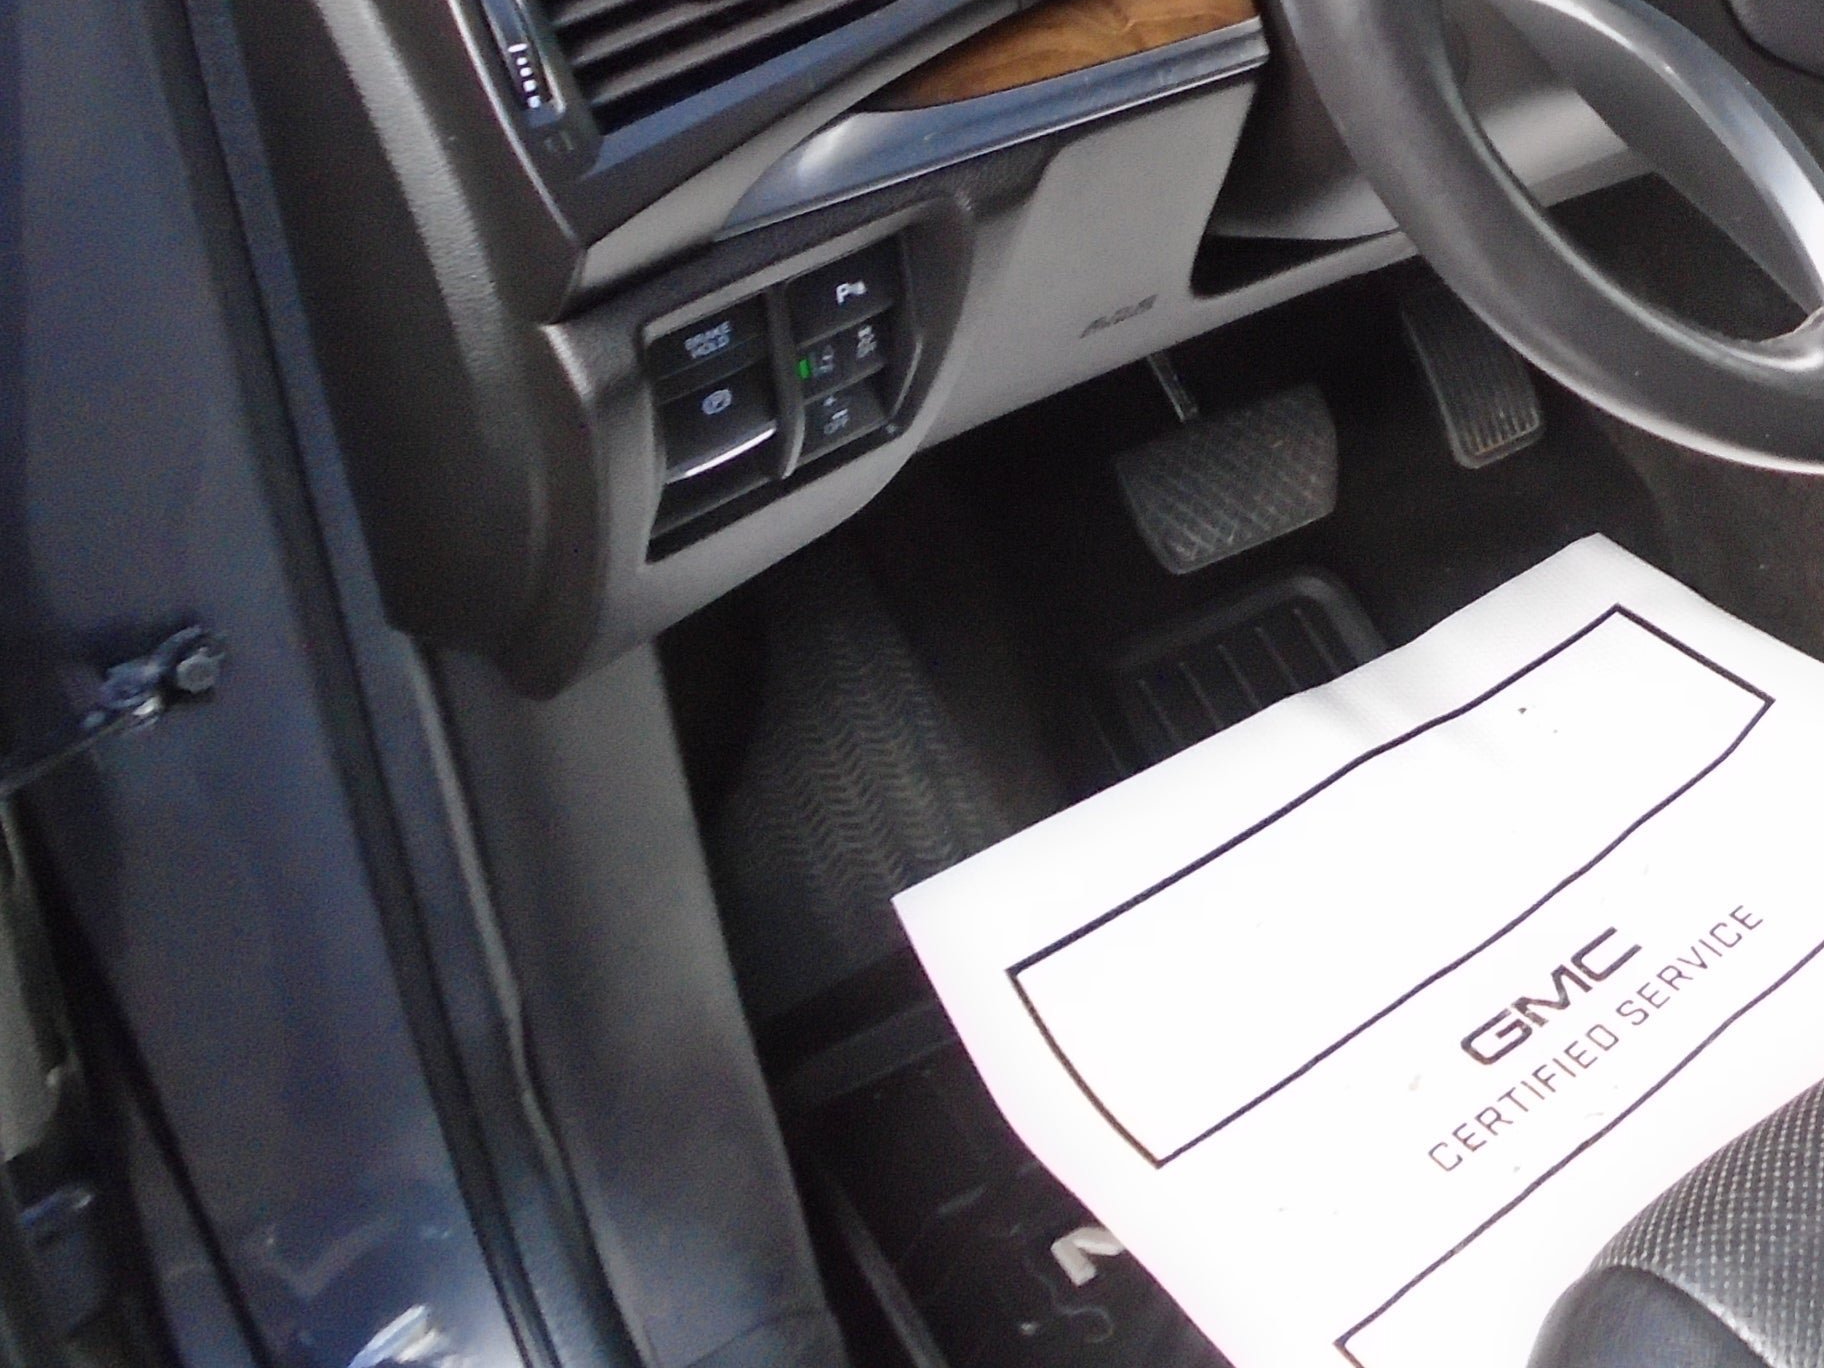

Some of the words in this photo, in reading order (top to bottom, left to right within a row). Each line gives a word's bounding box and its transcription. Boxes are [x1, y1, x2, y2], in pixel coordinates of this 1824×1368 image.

[1428, 1024, 1620, 1172] CERTIFIED
[1615, 904, 1764, 1026] SERVICE
[1460, 926, 1642, 1065] GMC
